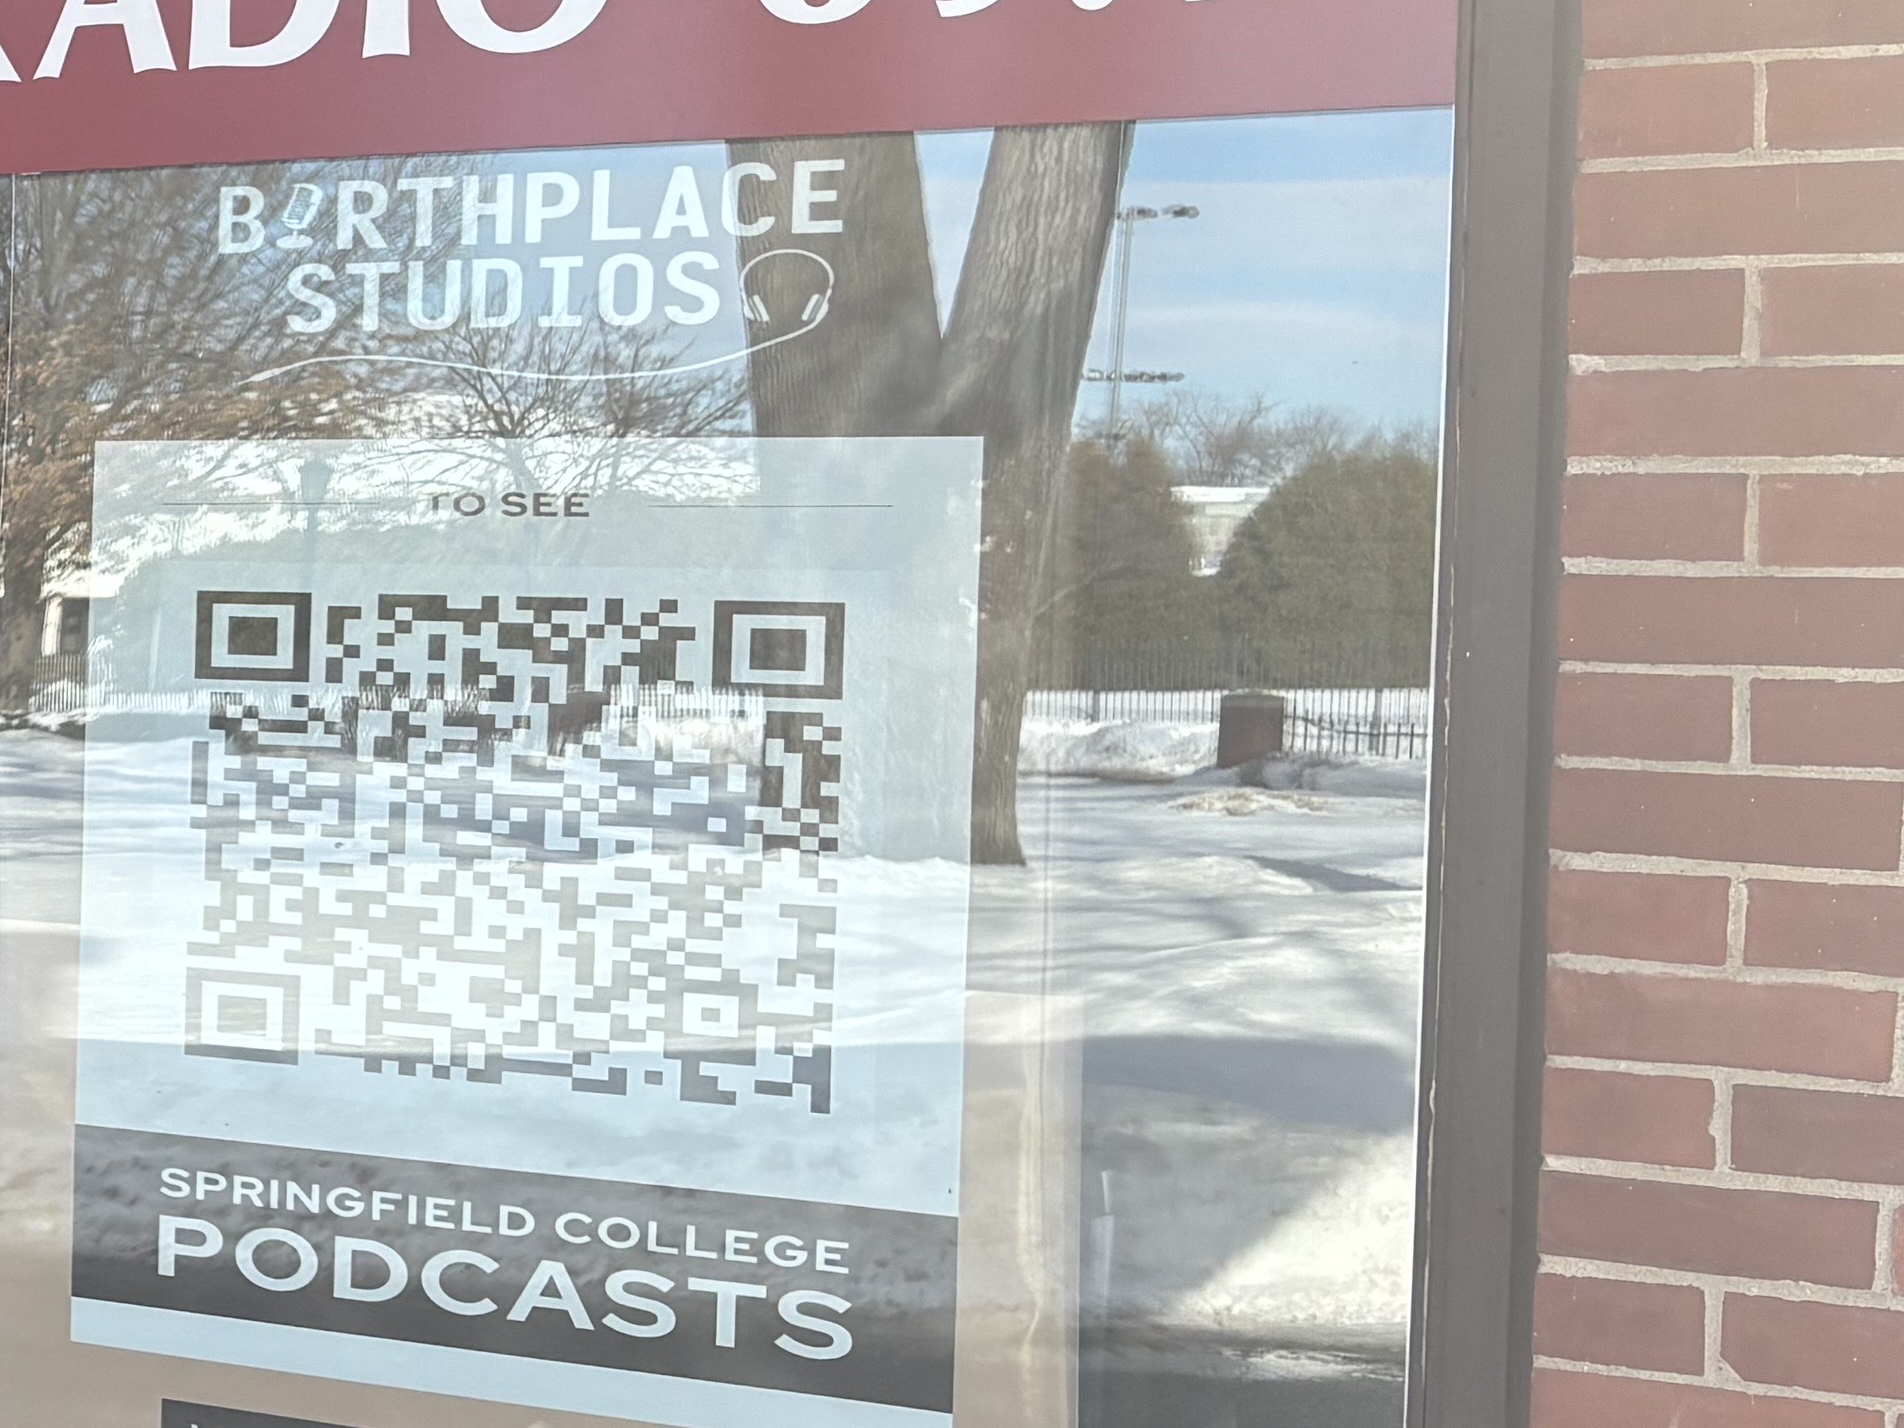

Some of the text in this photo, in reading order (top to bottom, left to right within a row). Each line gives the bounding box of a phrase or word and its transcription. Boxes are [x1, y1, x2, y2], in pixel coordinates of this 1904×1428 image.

[286, 251, 720, 334] STUDIOS
[430, 491, 591, 517] TO SEE
[160, 1167, 851, 1275] SPRINGFIELD COLLEGE
[157, 1214, 854, 1360] PODCASTS
